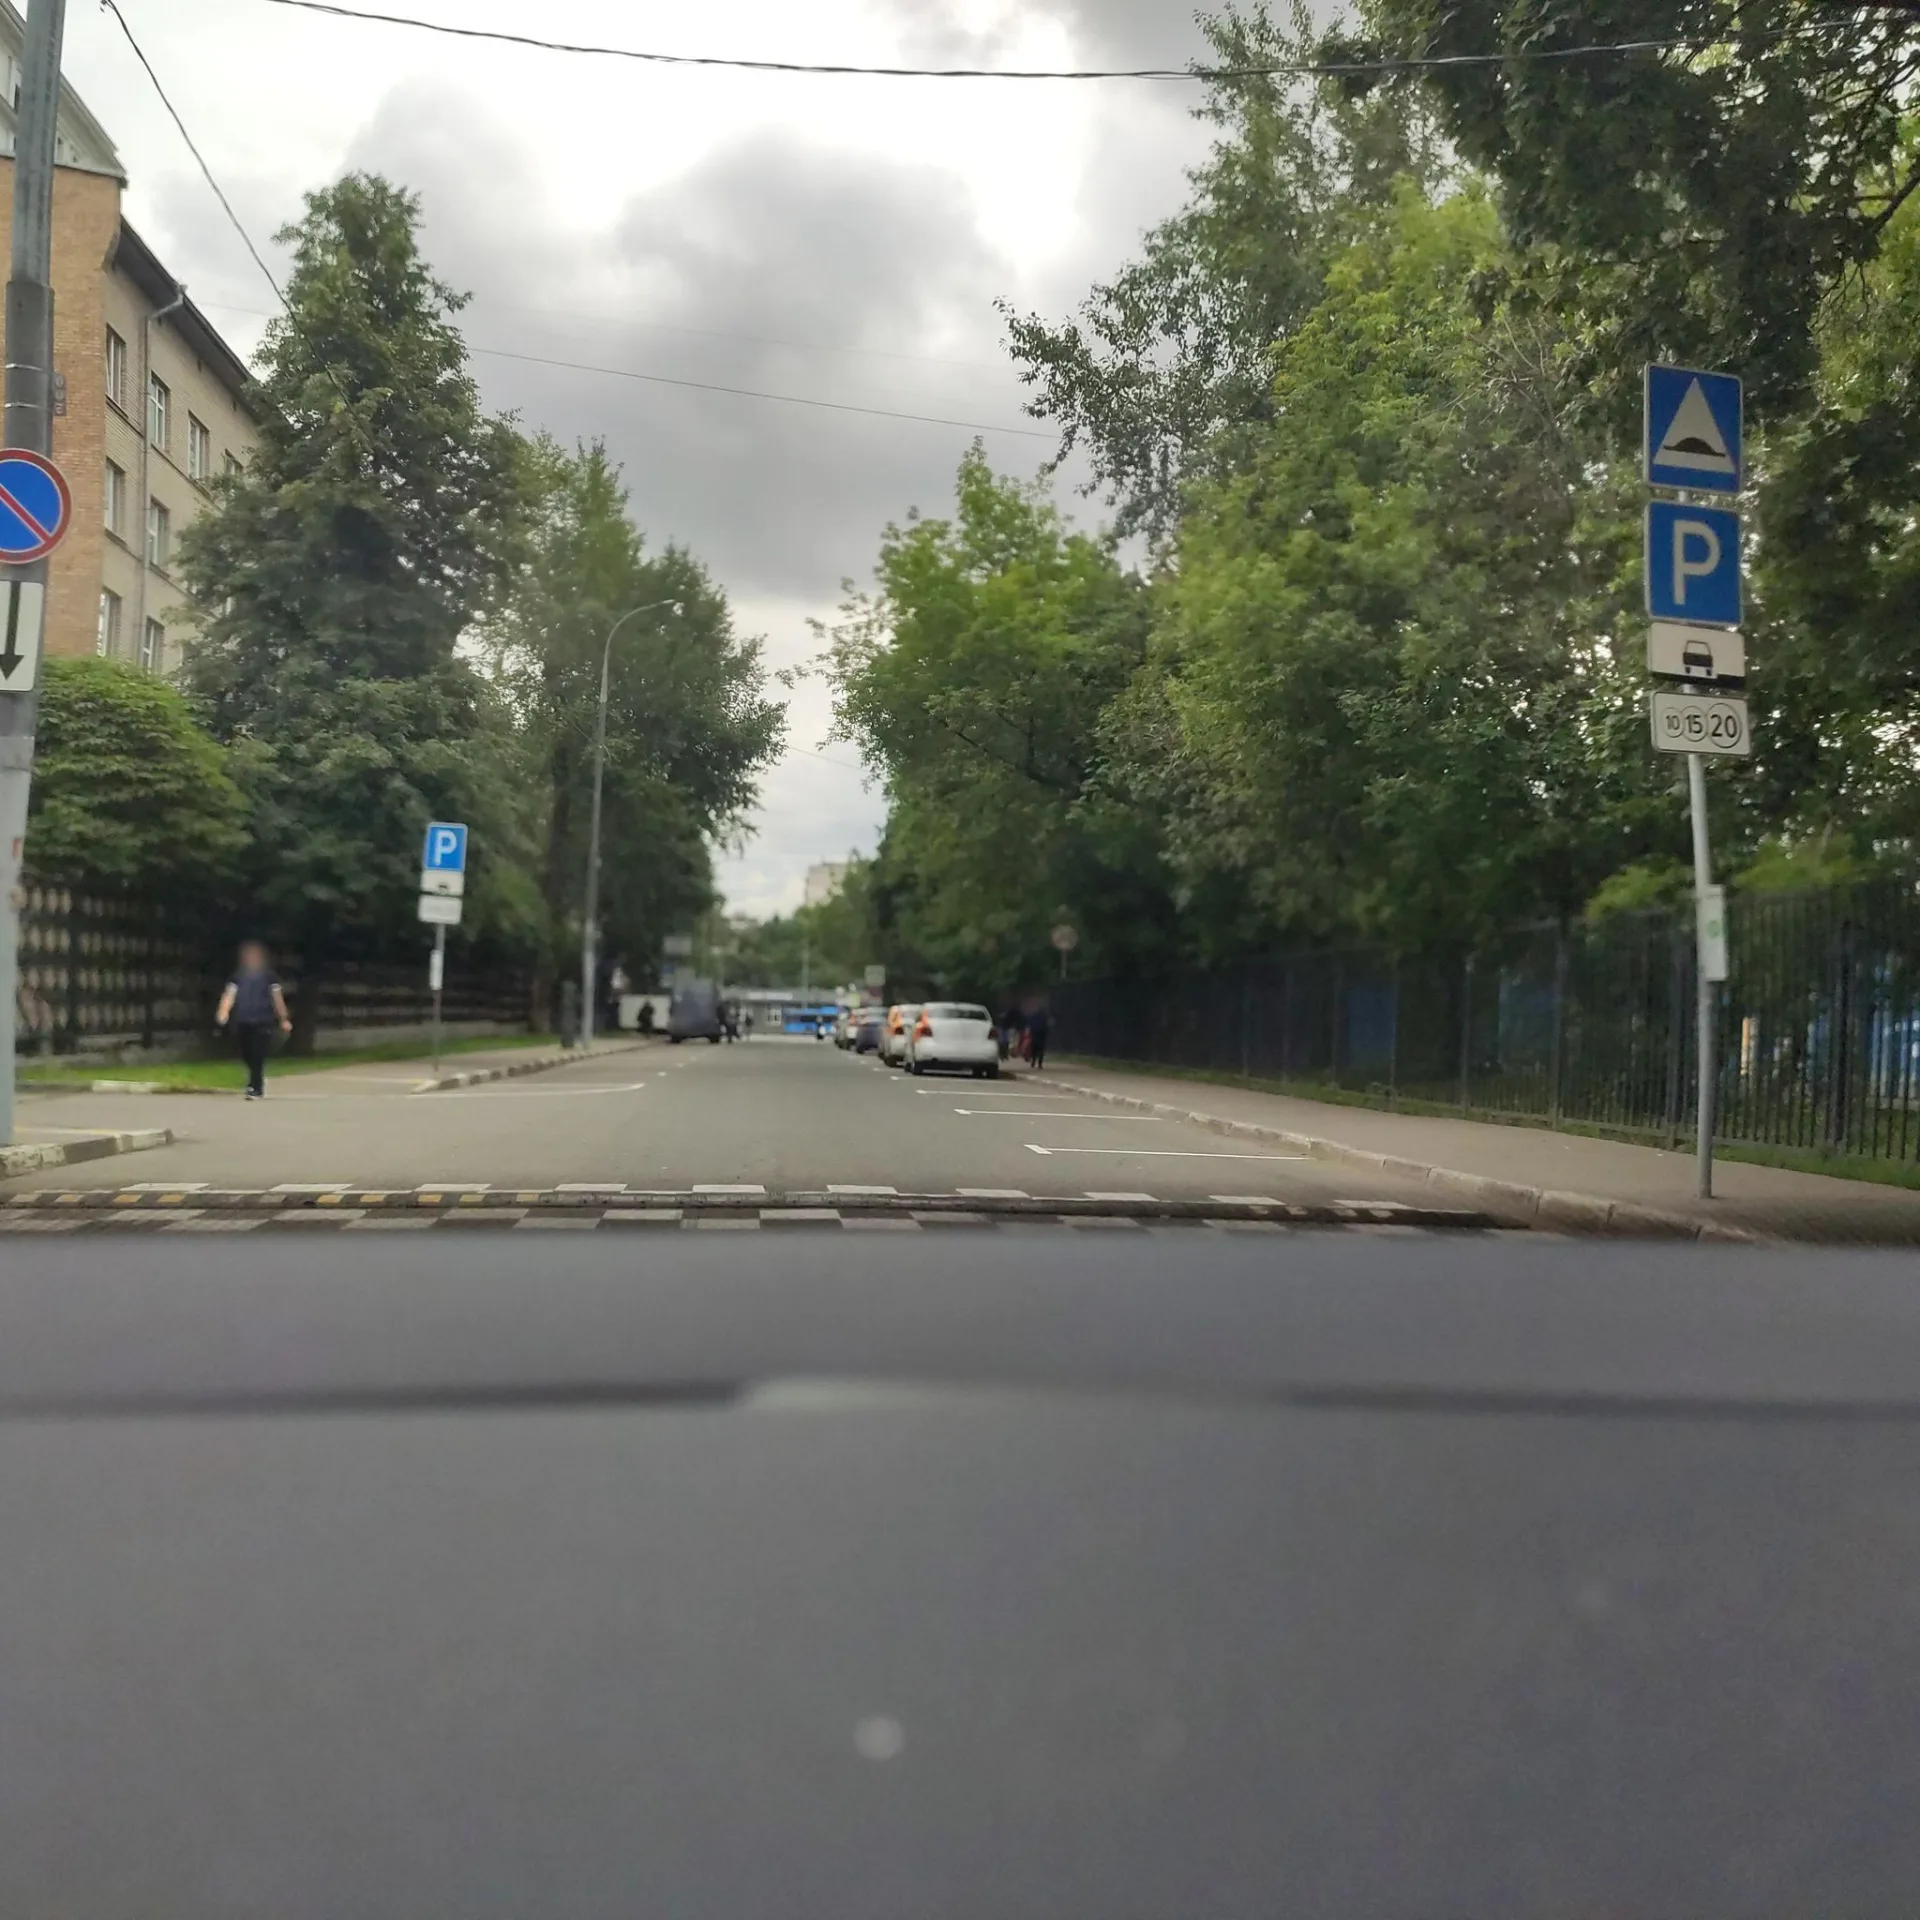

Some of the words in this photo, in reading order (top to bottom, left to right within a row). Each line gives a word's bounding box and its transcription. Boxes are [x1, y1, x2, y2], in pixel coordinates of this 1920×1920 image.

[1673, 519, 1720, 605] P
[1665, 715, 1680, 730] 10
[1685, 714, 1703, 734] 15
[1710, 714, 1737, 738] 20
[434, 830, 457, 866] P
